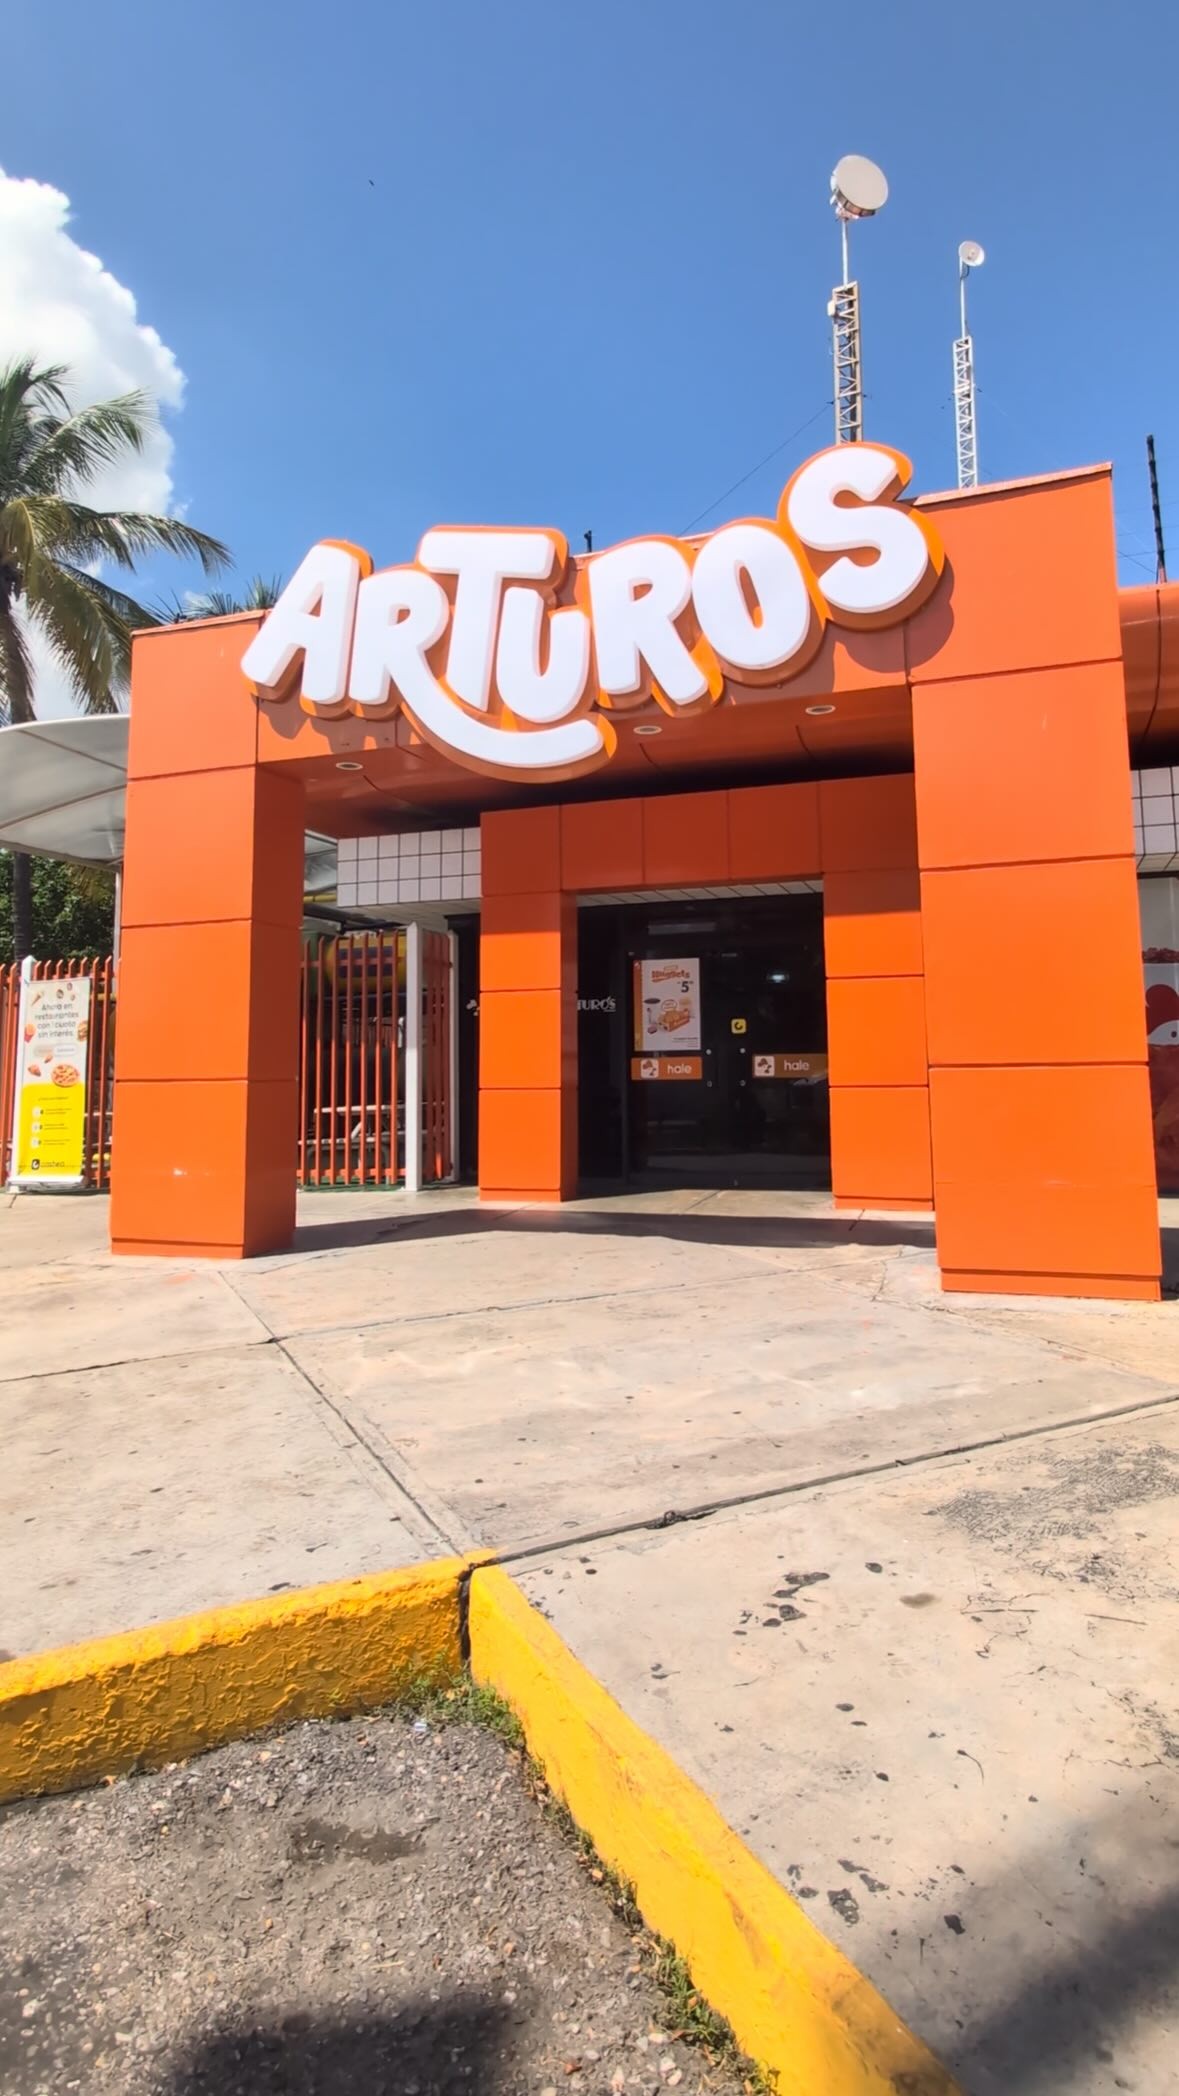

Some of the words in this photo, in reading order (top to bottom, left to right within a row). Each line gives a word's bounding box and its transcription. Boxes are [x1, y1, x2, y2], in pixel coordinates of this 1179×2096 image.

[241, 445, 930, 770] ARTUROS
[667, 1063, 692, 1075] hale
[784, 1060, 810, 1071] hale
